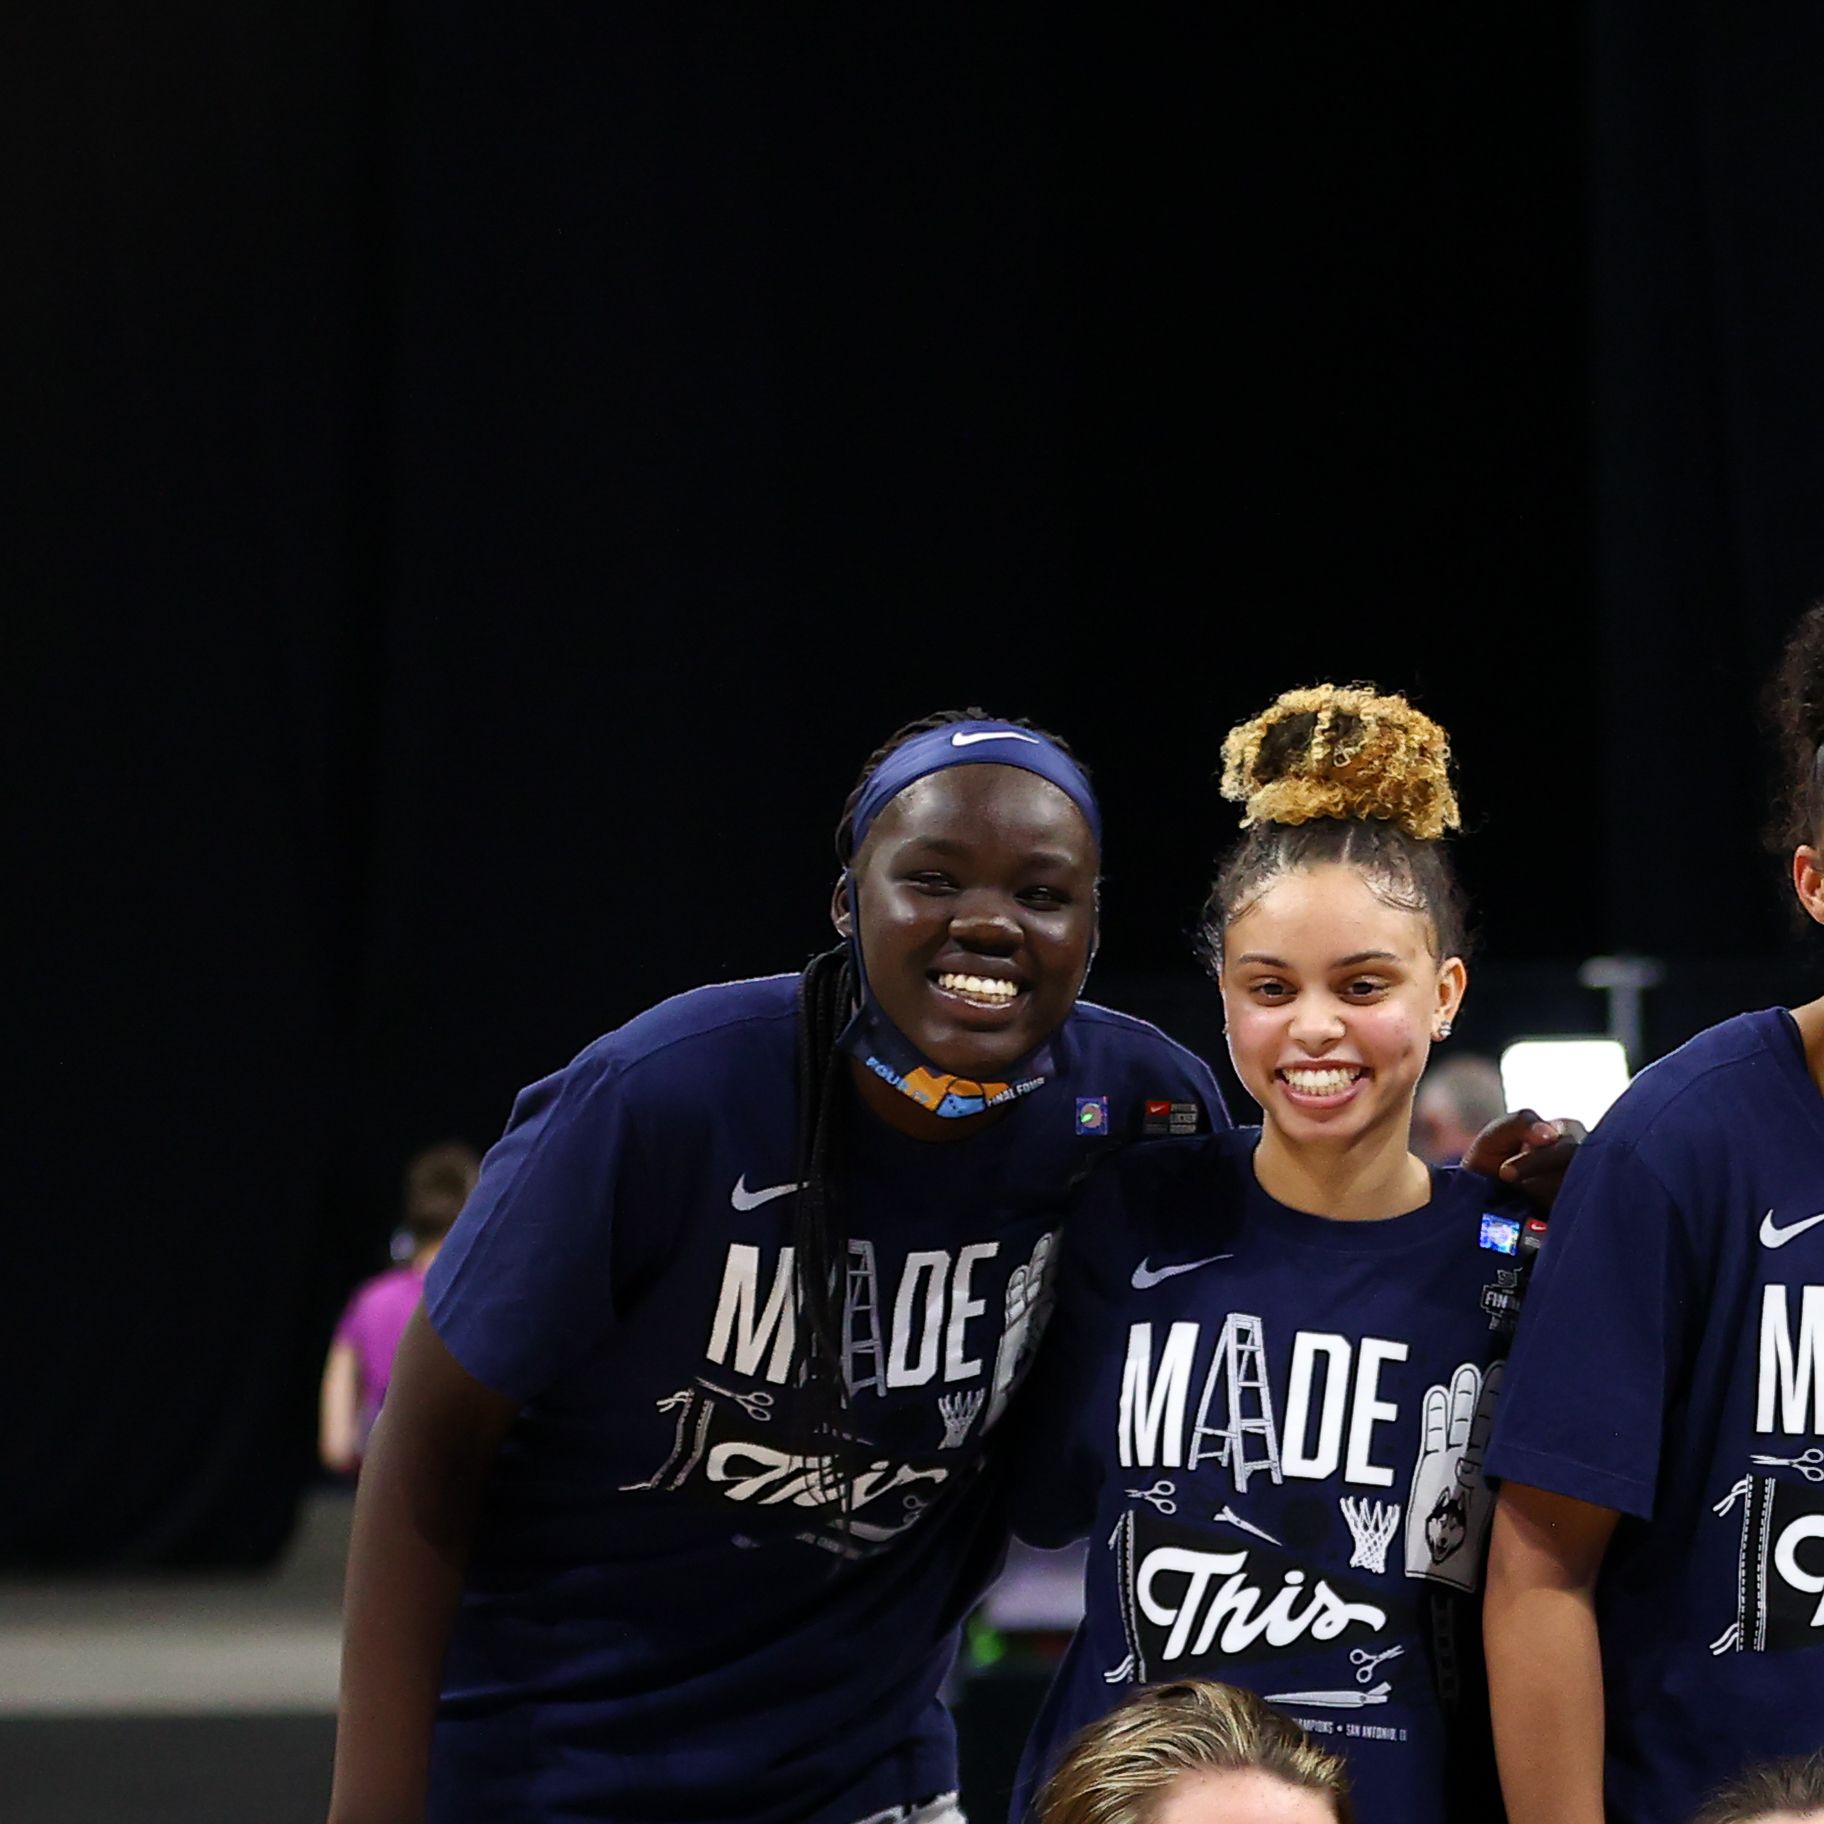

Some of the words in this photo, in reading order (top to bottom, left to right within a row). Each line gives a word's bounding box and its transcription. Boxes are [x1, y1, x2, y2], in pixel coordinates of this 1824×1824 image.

[1118, 1312, 1409, 1493] MADE
[1137, 1546, 1386, 1661] This
[1346, 1723, 1361, 1737] SAN
